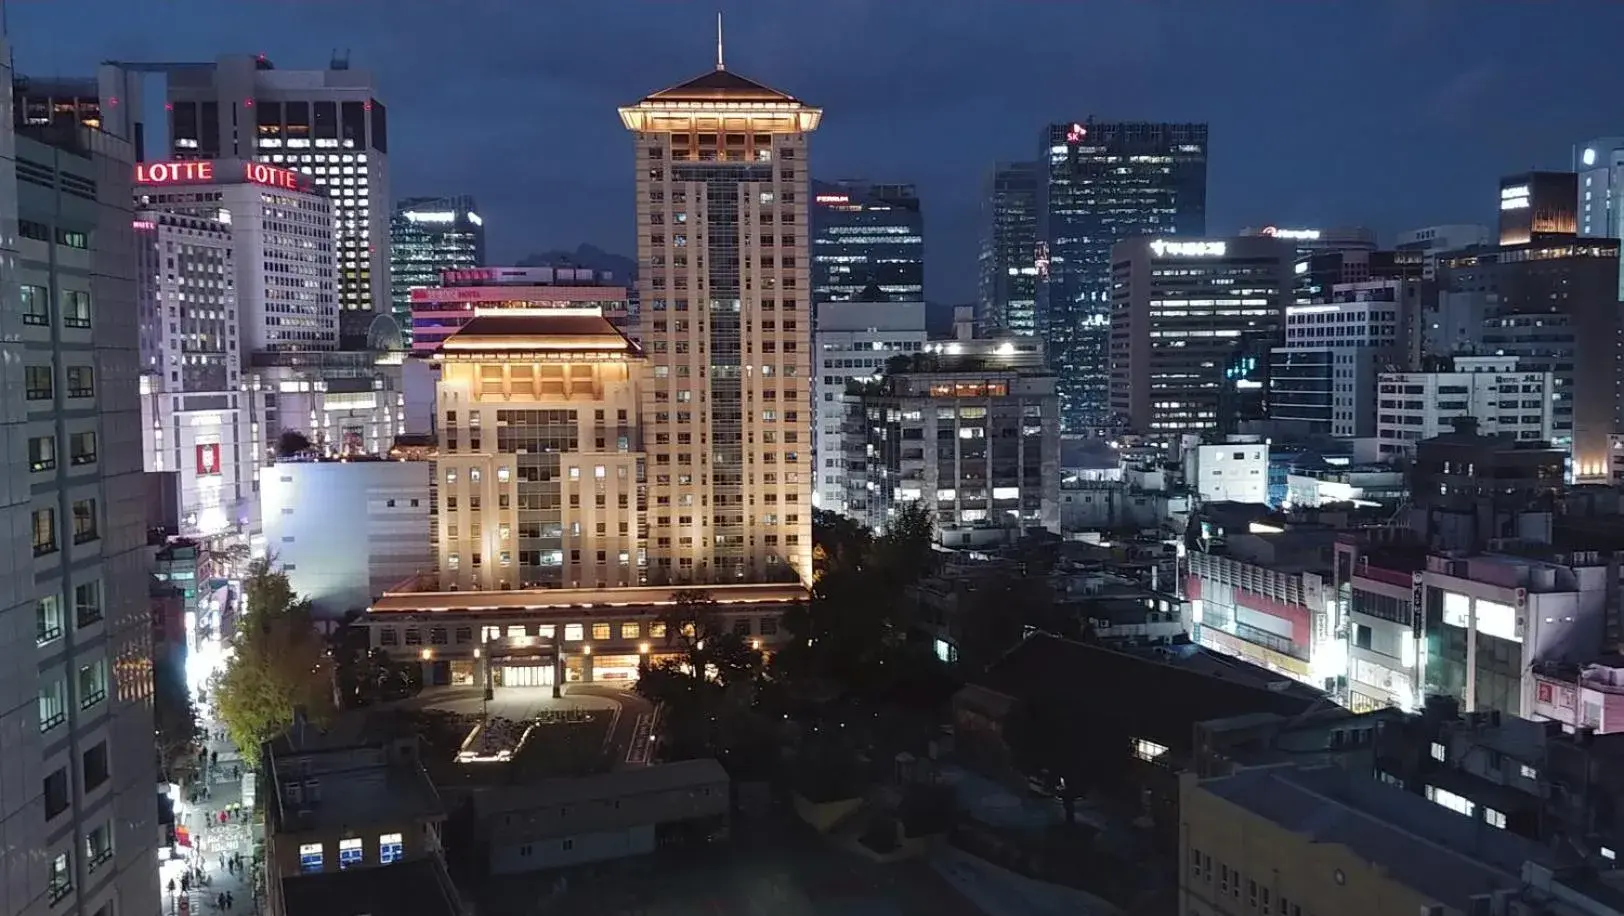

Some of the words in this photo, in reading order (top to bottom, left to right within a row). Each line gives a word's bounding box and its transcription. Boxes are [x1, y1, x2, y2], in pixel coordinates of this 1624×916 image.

[1067, 132, 1079, 141] SK
[137, 161, 212, 182] LOTTE
[246, 162, 297, 189] LOTTE
